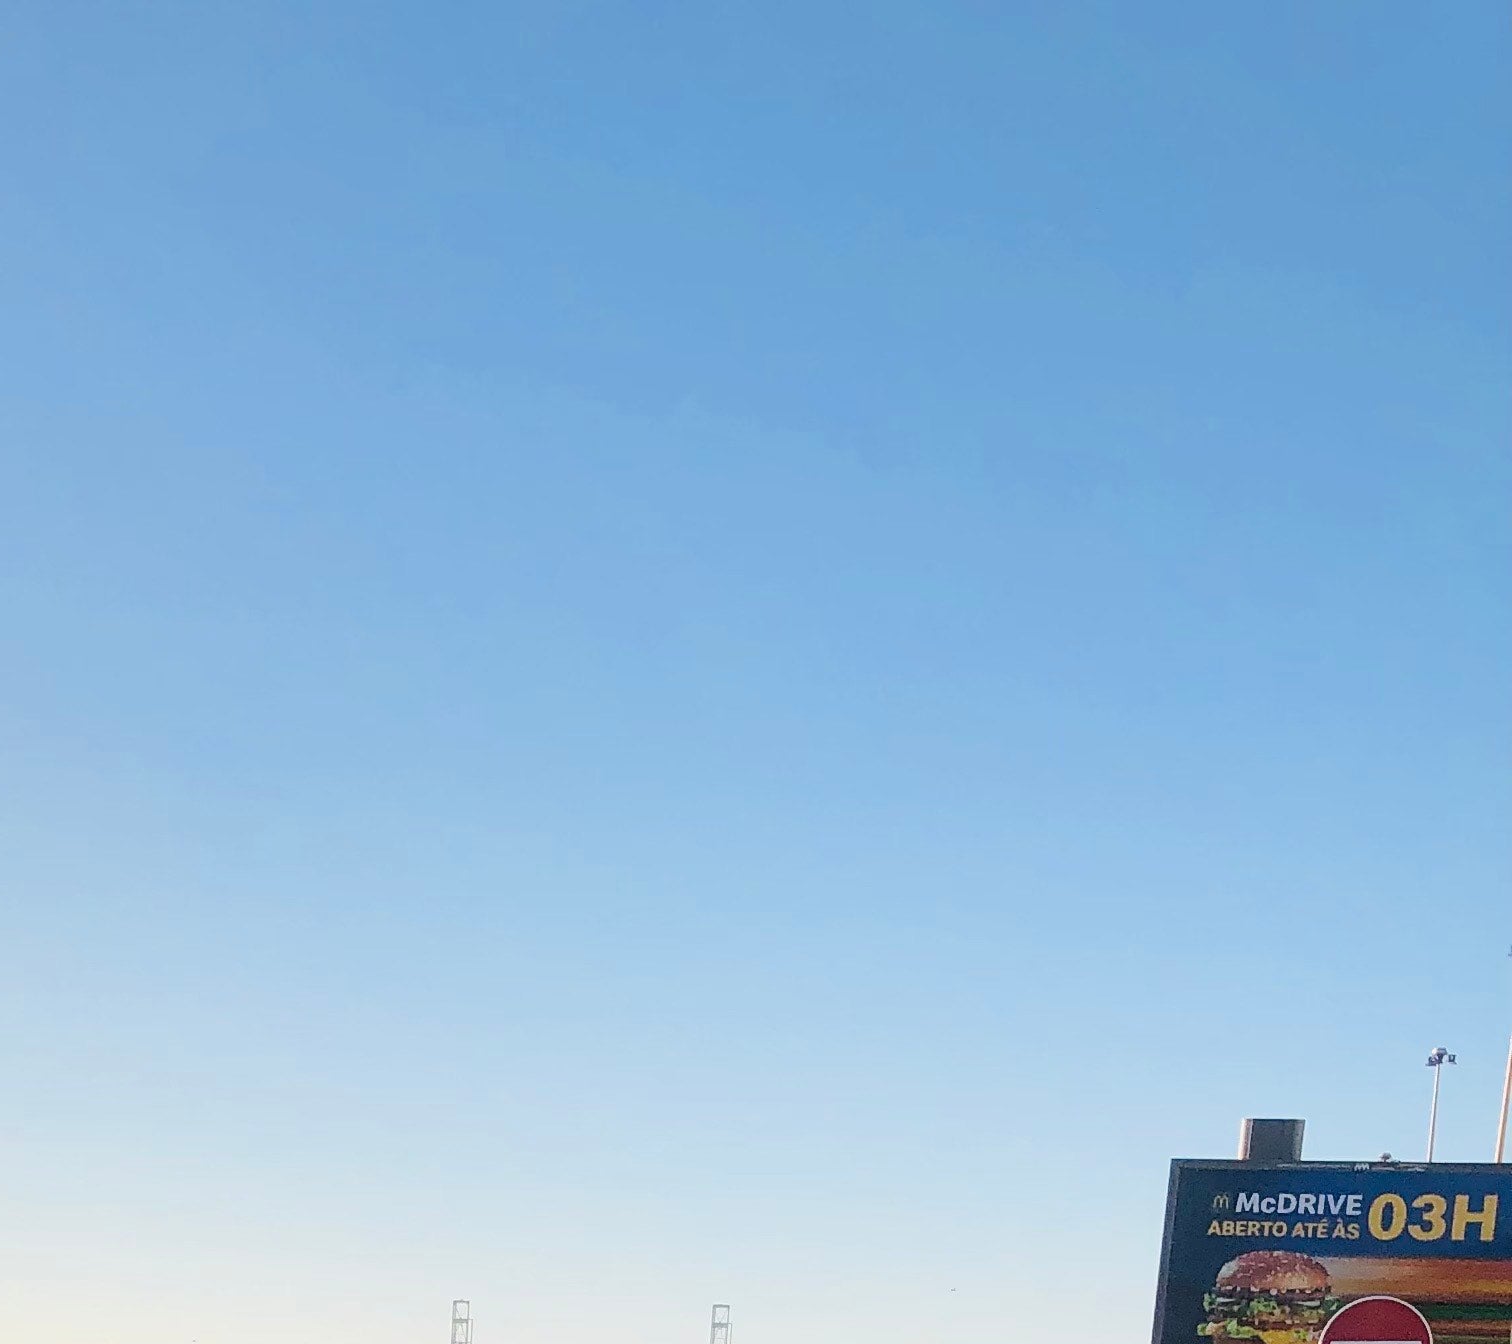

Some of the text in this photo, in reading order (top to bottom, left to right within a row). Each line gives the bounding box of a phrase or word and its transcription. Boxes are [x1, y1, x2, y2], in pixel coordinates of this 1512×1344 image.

[1207, 1217, 1361, 1240] ABERTO ATÉ ÀS
[1235, 1192, 1499, 1242] McDRIVE 03H
